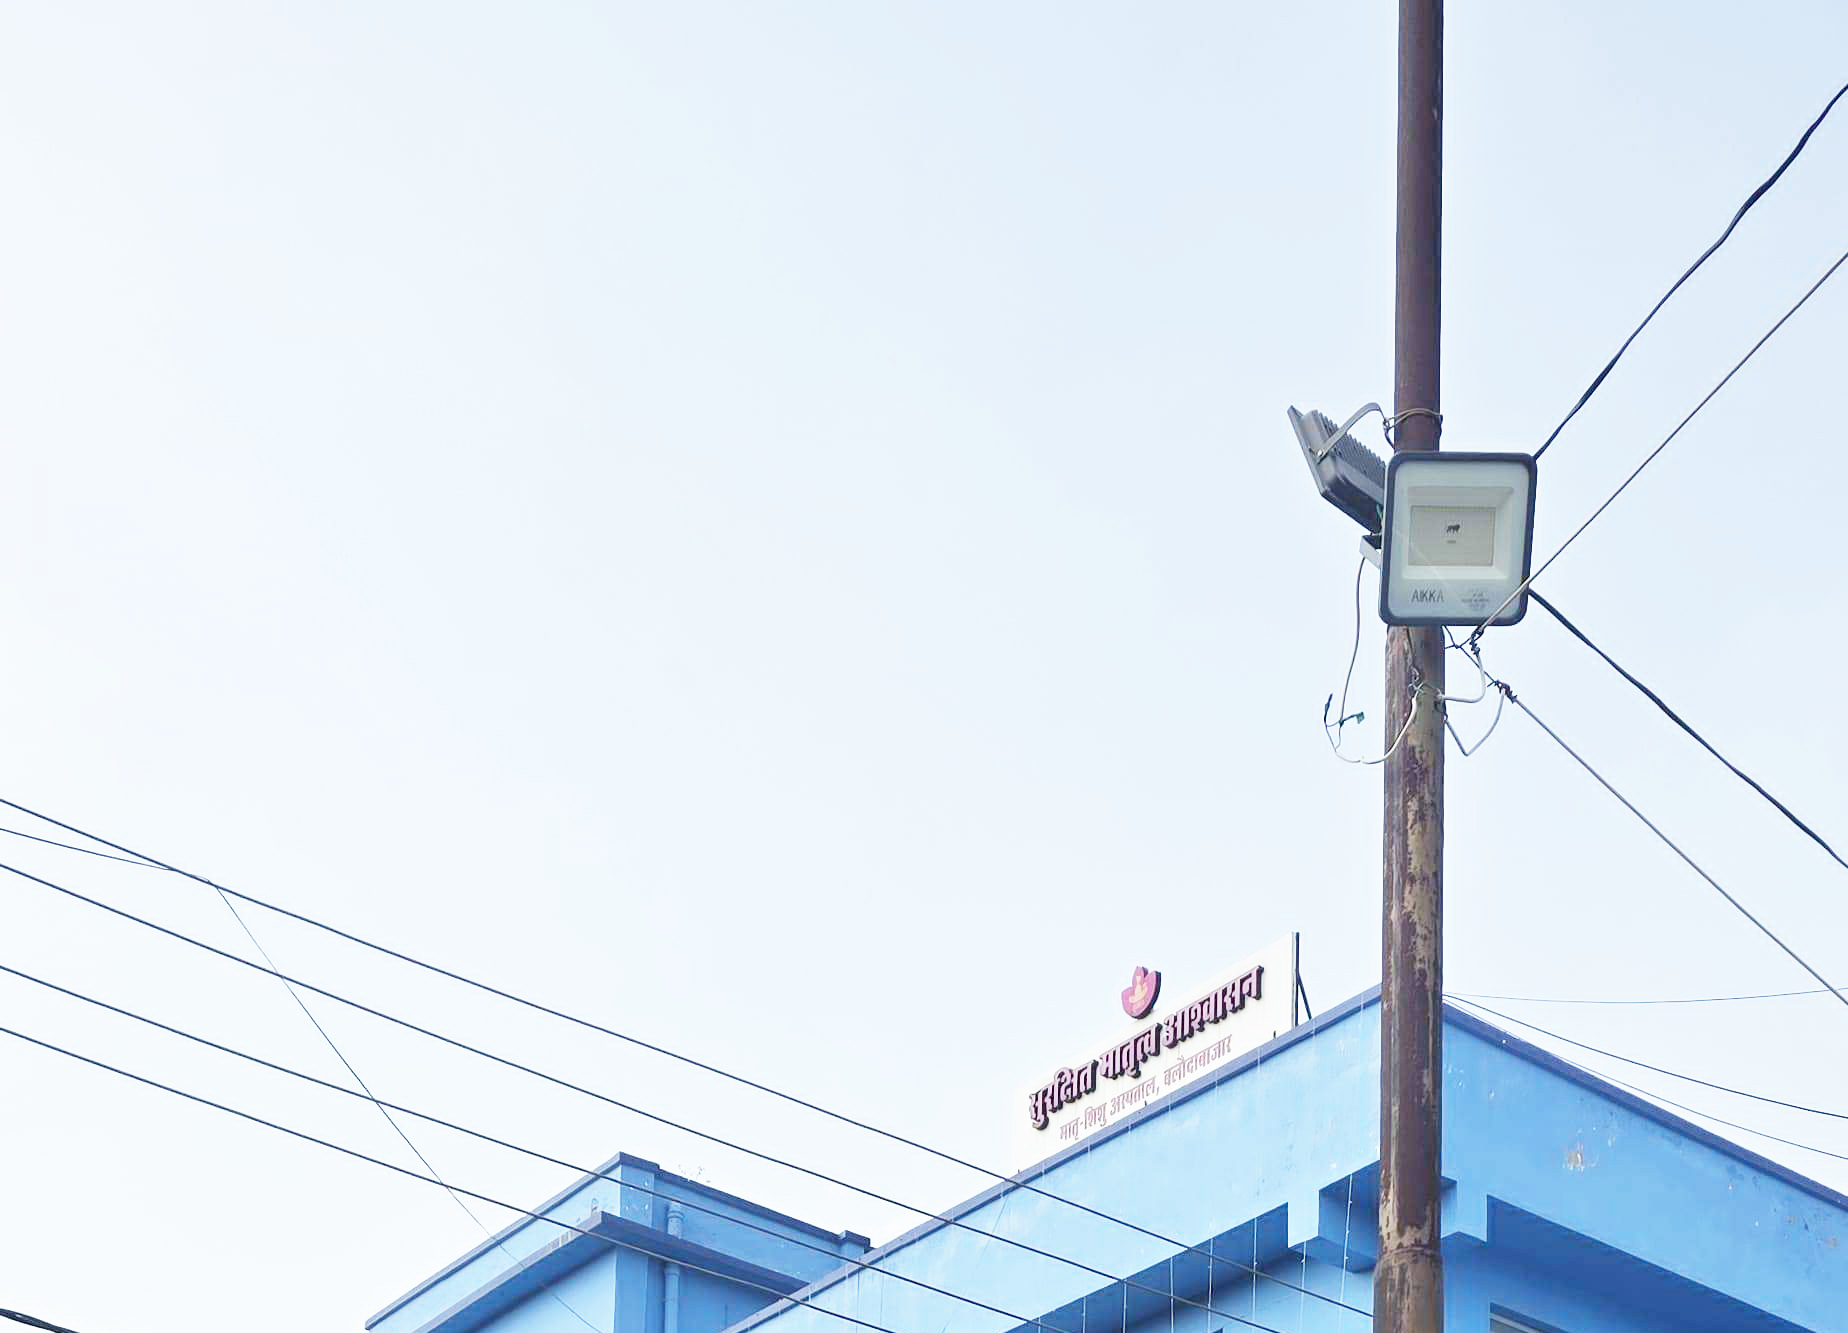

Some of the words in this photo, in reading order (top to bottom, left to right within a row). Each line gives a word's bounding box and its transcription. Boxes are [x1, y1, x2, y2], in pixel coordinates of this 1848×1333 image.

[1029, 1059, 1099, 1130] सुरक्षित
[1162, 965, 1264, 1049] आश्वासन
[1163, 1034, 1233, 1087] बलौदाबाजार
